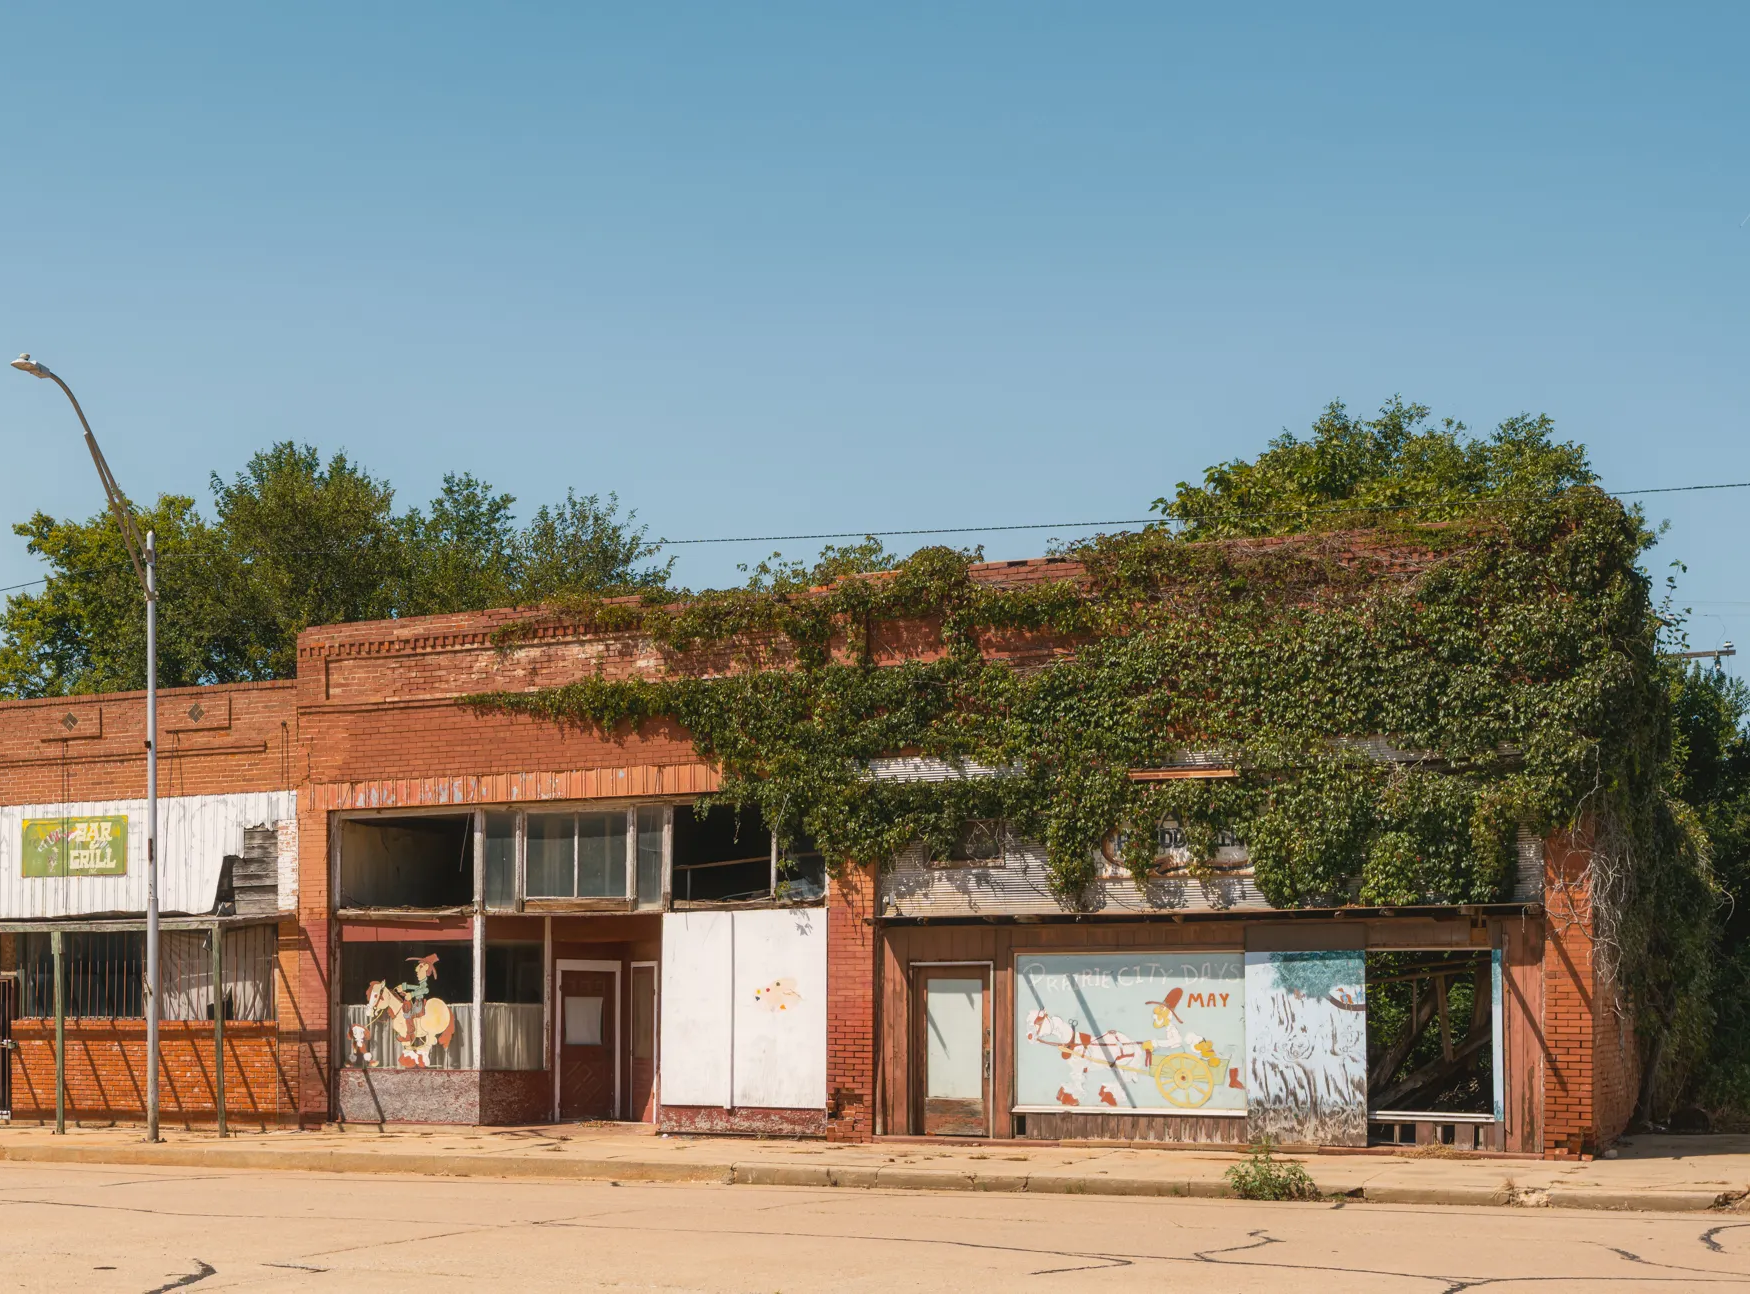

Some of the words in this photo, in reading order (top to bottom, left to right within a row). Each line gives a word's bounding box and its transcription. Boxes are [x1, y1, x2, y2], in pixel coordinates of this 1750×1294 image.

[75, 822, 112, 841] BAR
[70, 848, 116, 869] GRILL
[1022, 963, 1112, 991] PRAIRIE
[1118, 962, 1174, 986] CITY
[1180, 962, 1243, 985] DAYS
[1187, 993, 1230, 1008] MAY
